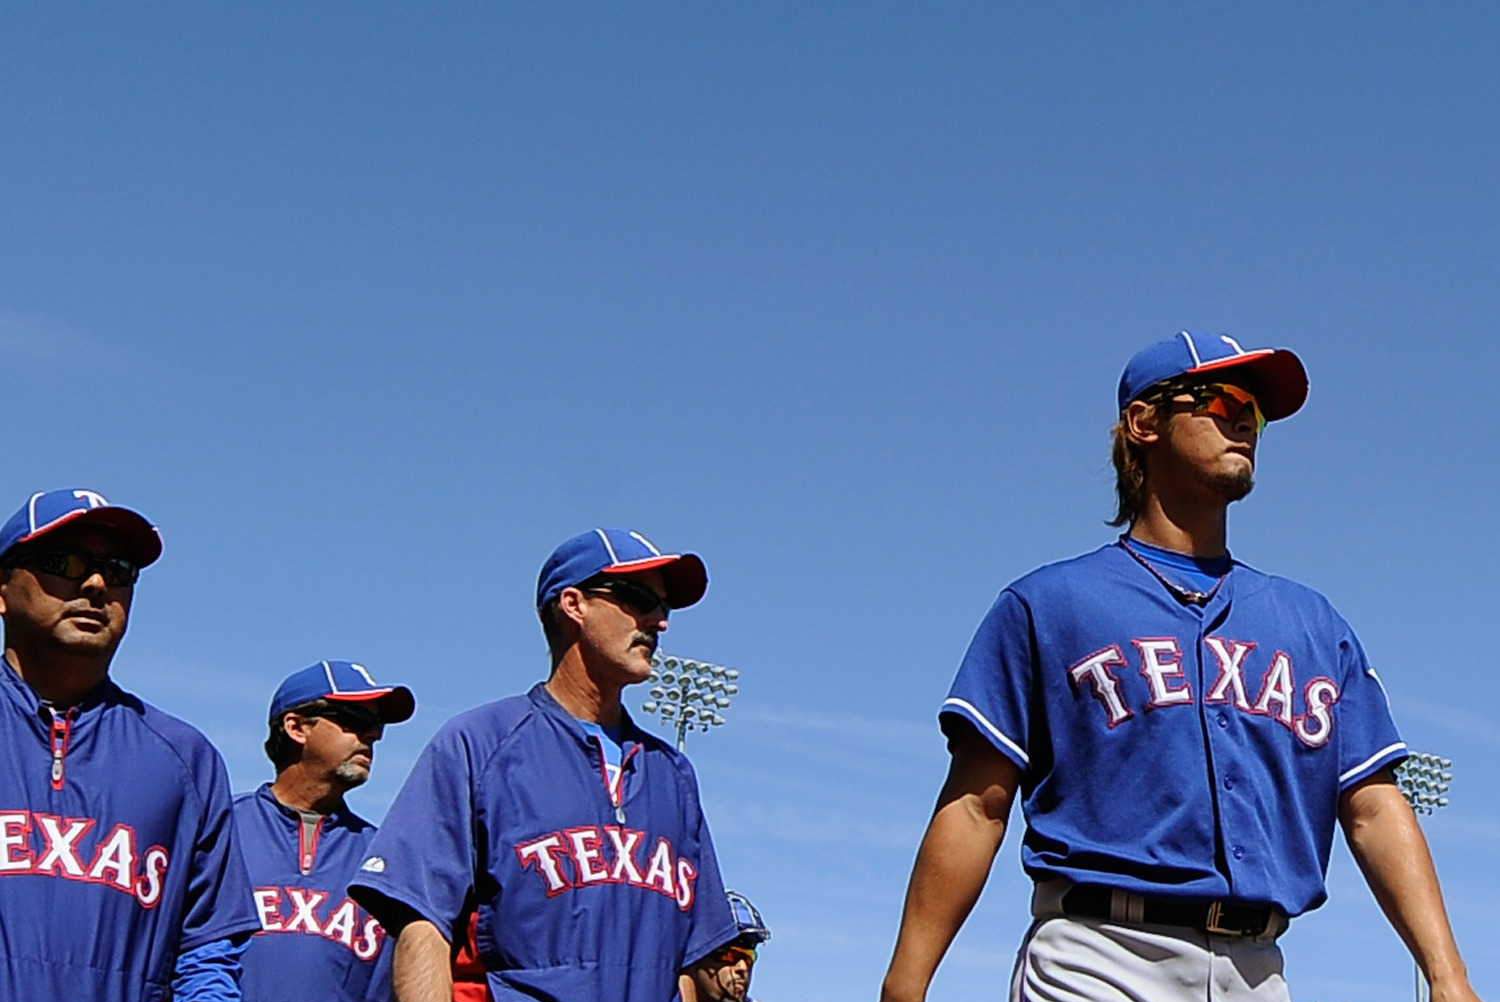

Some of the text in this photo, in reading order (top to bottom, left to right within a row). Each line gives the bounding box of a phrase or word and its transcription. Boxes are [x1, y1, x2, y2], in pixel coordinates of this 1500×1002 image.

[1067, 636, 1340, 749] TEXAS
[0, 809, 169, 909] EXAS
[515, 824, 697, 911] TEXAS
[252, 886, 387, 962] EXAS
